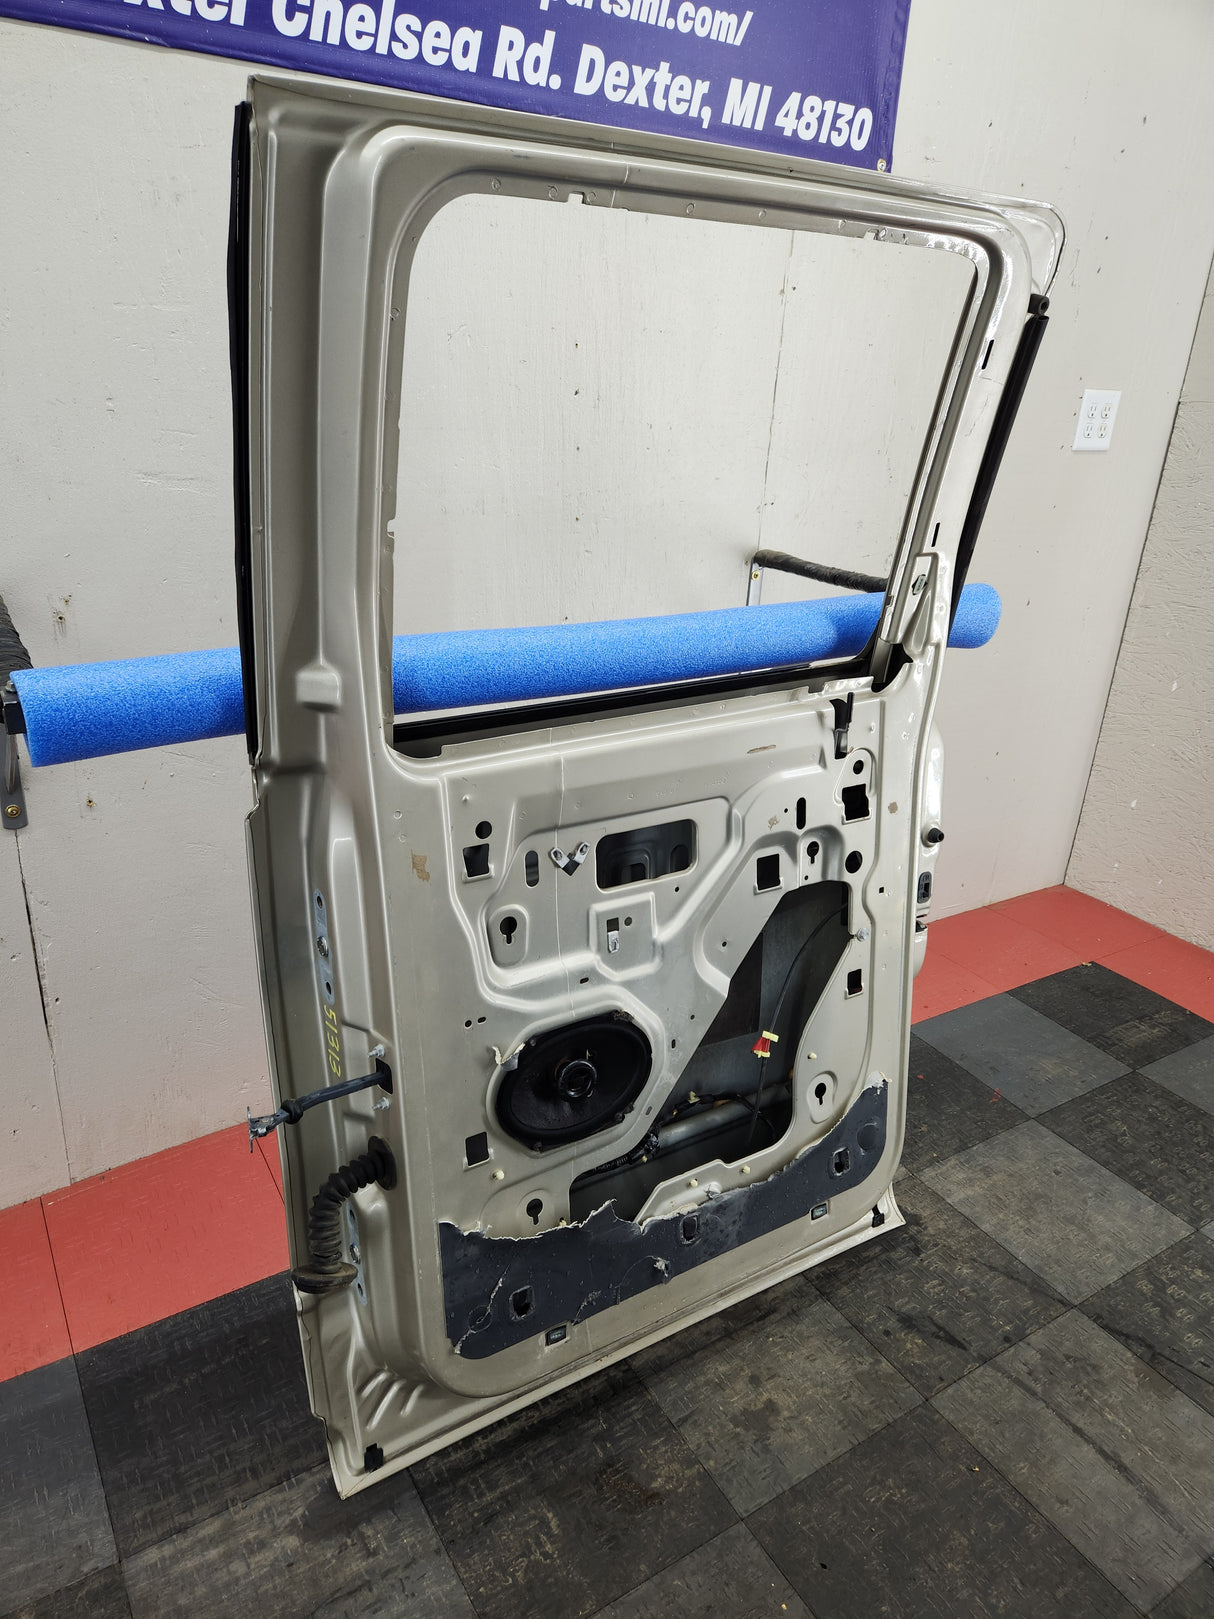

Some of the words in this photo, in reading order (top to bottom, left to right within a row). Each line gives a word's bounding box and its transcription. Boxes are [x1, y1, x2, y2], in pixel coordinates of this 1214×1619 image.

[272, 0, 483, 73] Chelsea
[492, 25, 562, 90] Rd.
[573, 43, 711, 128] Dexter,
[721, 77, 773, 131] MI
[774, 91, 874, 151] 48130
